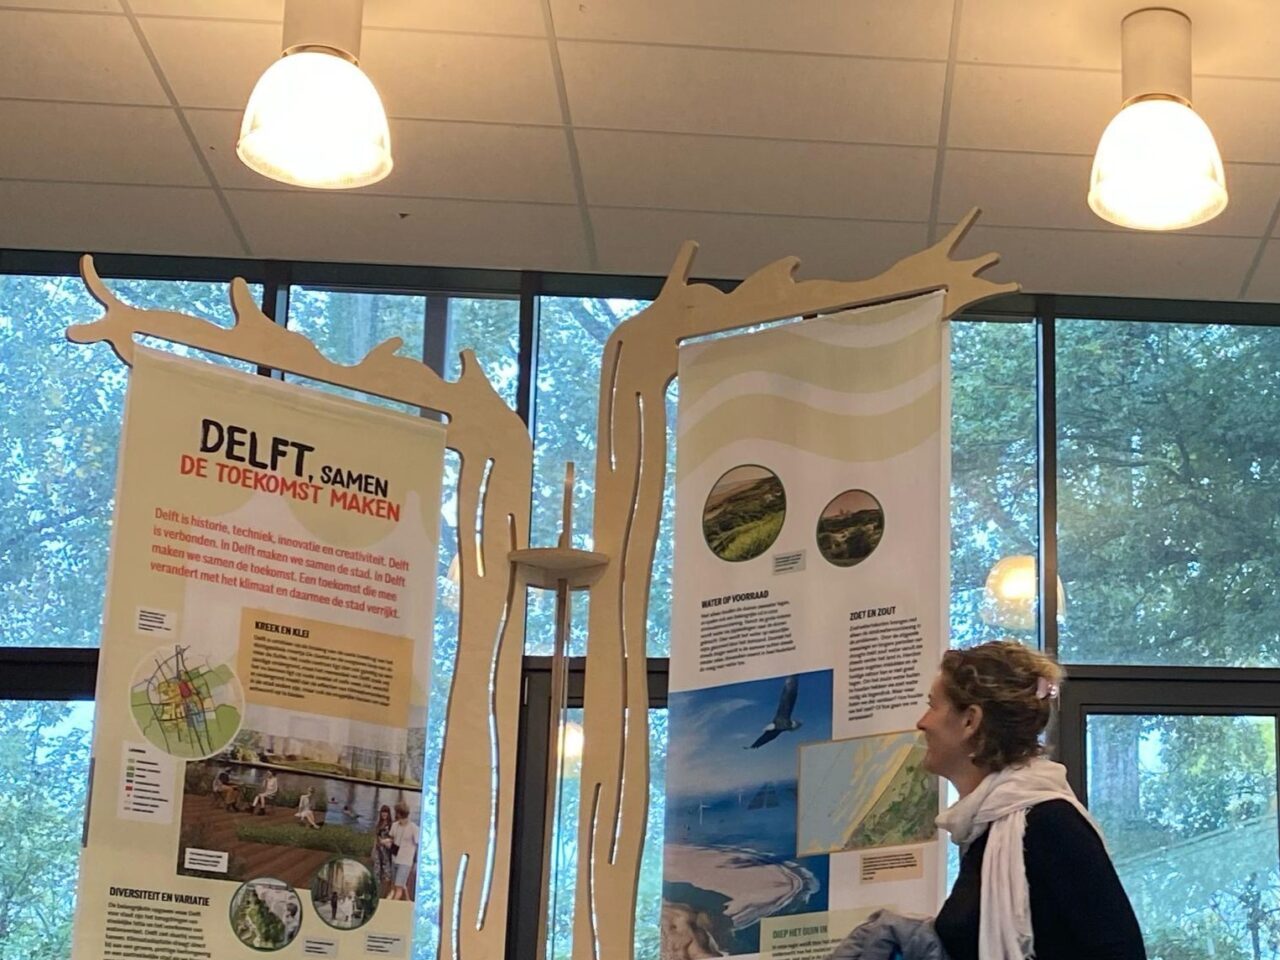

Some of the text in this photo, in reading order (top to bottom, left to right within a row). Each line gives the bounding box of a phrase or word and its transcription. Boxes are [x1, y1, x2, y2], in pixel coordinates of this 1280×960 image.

[200, 418, 388, 498] DELFT, SAMEN
[180, 454, 400, 522] DE TOEKOMST MAKEN
[153, 527, 406, 587] is verbonden. In Delft maken we samen de stad. In Delft
[155, 508, 179, 523] Delft
[182, 514, 189, 524] is
[278, 537, 321, 552] innovatie
[322, 546, 334, 555] en
[389, 558, 409, 571] Delft
[150, 561, 198, 579] verandert
[200, 571, 219, 583] met
[221, 573, 237, 586] het
[239, 578, 274, 594] klimaat
[276, 587, 288, 596] en
[289, 588, 330, 604] daarmee
[332, 597, 344, 607] de
[345, 600, 365, 611] stad
[152, 544, 397, 601] maken we samen de toekomst. Een toekomst die mee
[850, 606, 896, 620] ZOET EN ZOUT
[109, 887, 210, 907] DIVERSITEIT EN VARIATIE
